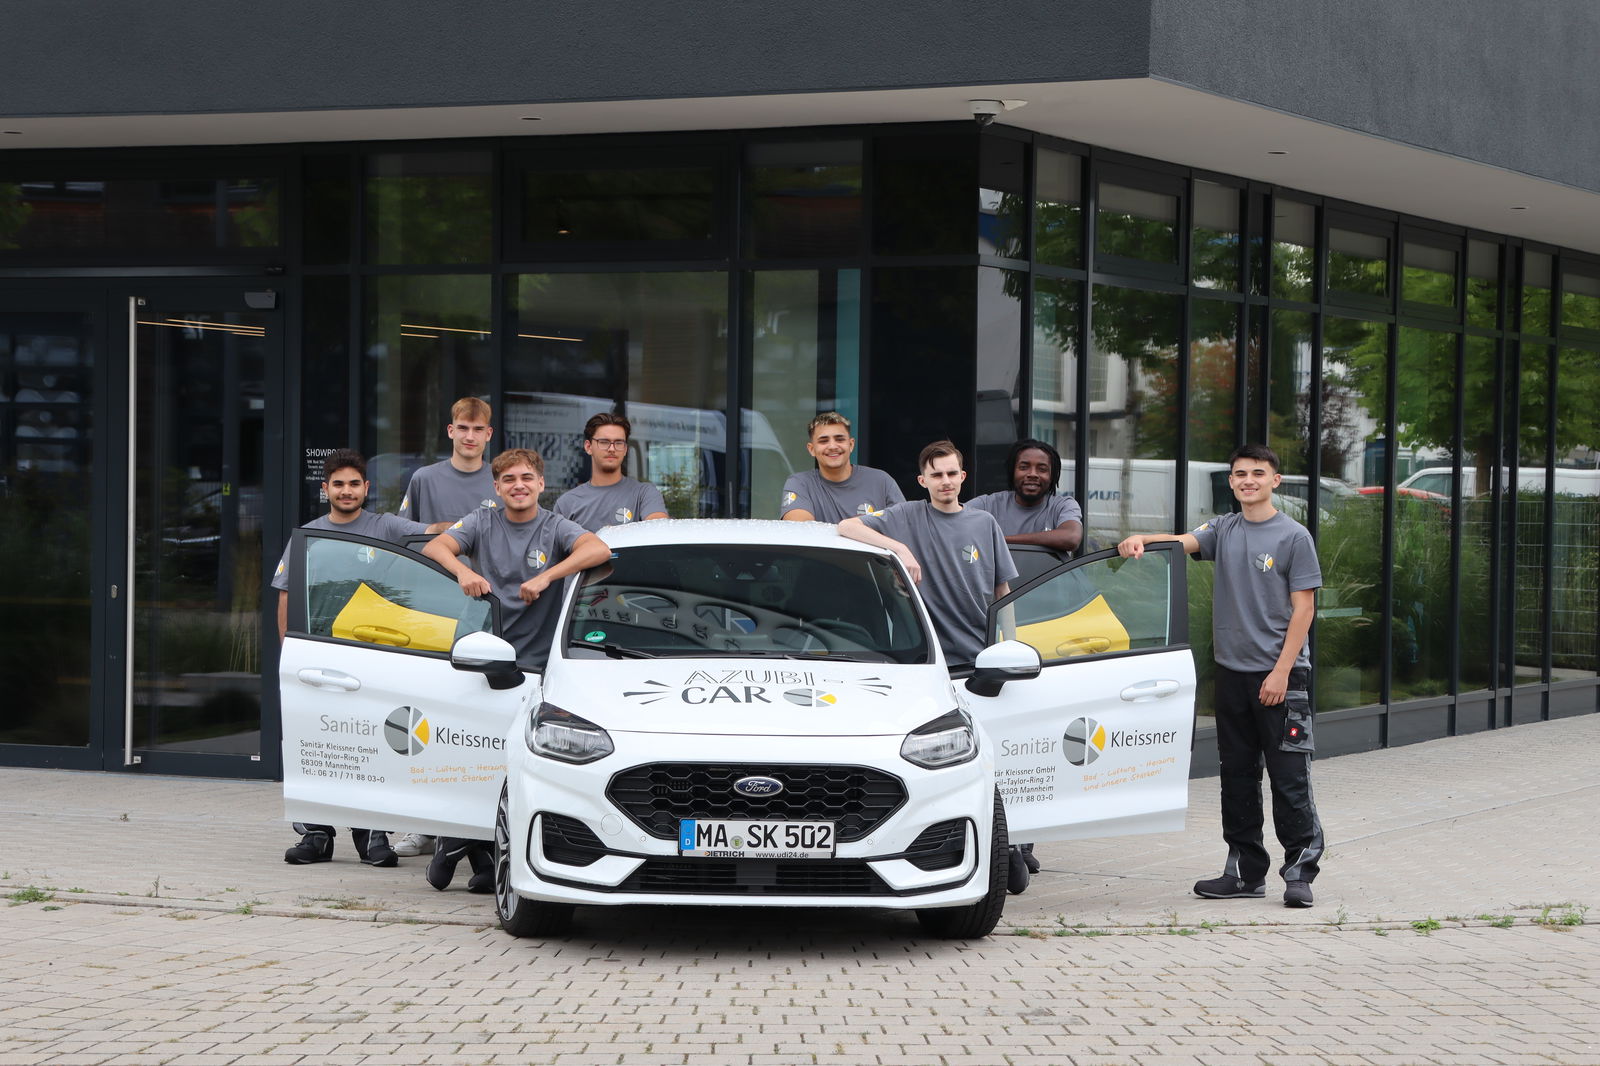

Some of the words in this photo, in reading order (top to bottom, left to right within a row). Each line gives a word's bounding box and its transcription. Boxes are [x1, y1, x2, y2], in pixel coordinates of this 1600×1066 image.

[306, 448, 336, 457] SHOWRO
[681, 686, 772, 705] CAR
[320, 714, 378, 737] Sanitär
[436, 726, 507, 751] Kleissner
[300, 740, 324, 749] Sanitär
[326, 742, 356, 753] Kleissner
[358, 746, 378, 755] GmbH
[1001, 738, 1057, 757] Sanitär
[1111, 730, 1177, 748] Kleissner
[300, 749, 359, 764] Cecil-Taylor-Ring
[301, 758, 323, 768] 68309
[325, 760, 361, 771] Mannheim
[1006, 768, 1034, 776] Kleissner
[1036, 766, 1056, 774] GmbH
[302, 767, 316, 776] Tel.:
[318, 769, 327, 777] 06
[368, 774, 385, 783] 03-0
[745, 780, 772, 792] Ford
[998, 787, 1018, 795] 8309
[1020, 786, 1054, 794] Mannheim
[1036, 794, 1053, 802] 03-0
[696, 824, 728, 848] MA
[746, 824, 779, 848] SK
[785, 825, 831, 849] 502
